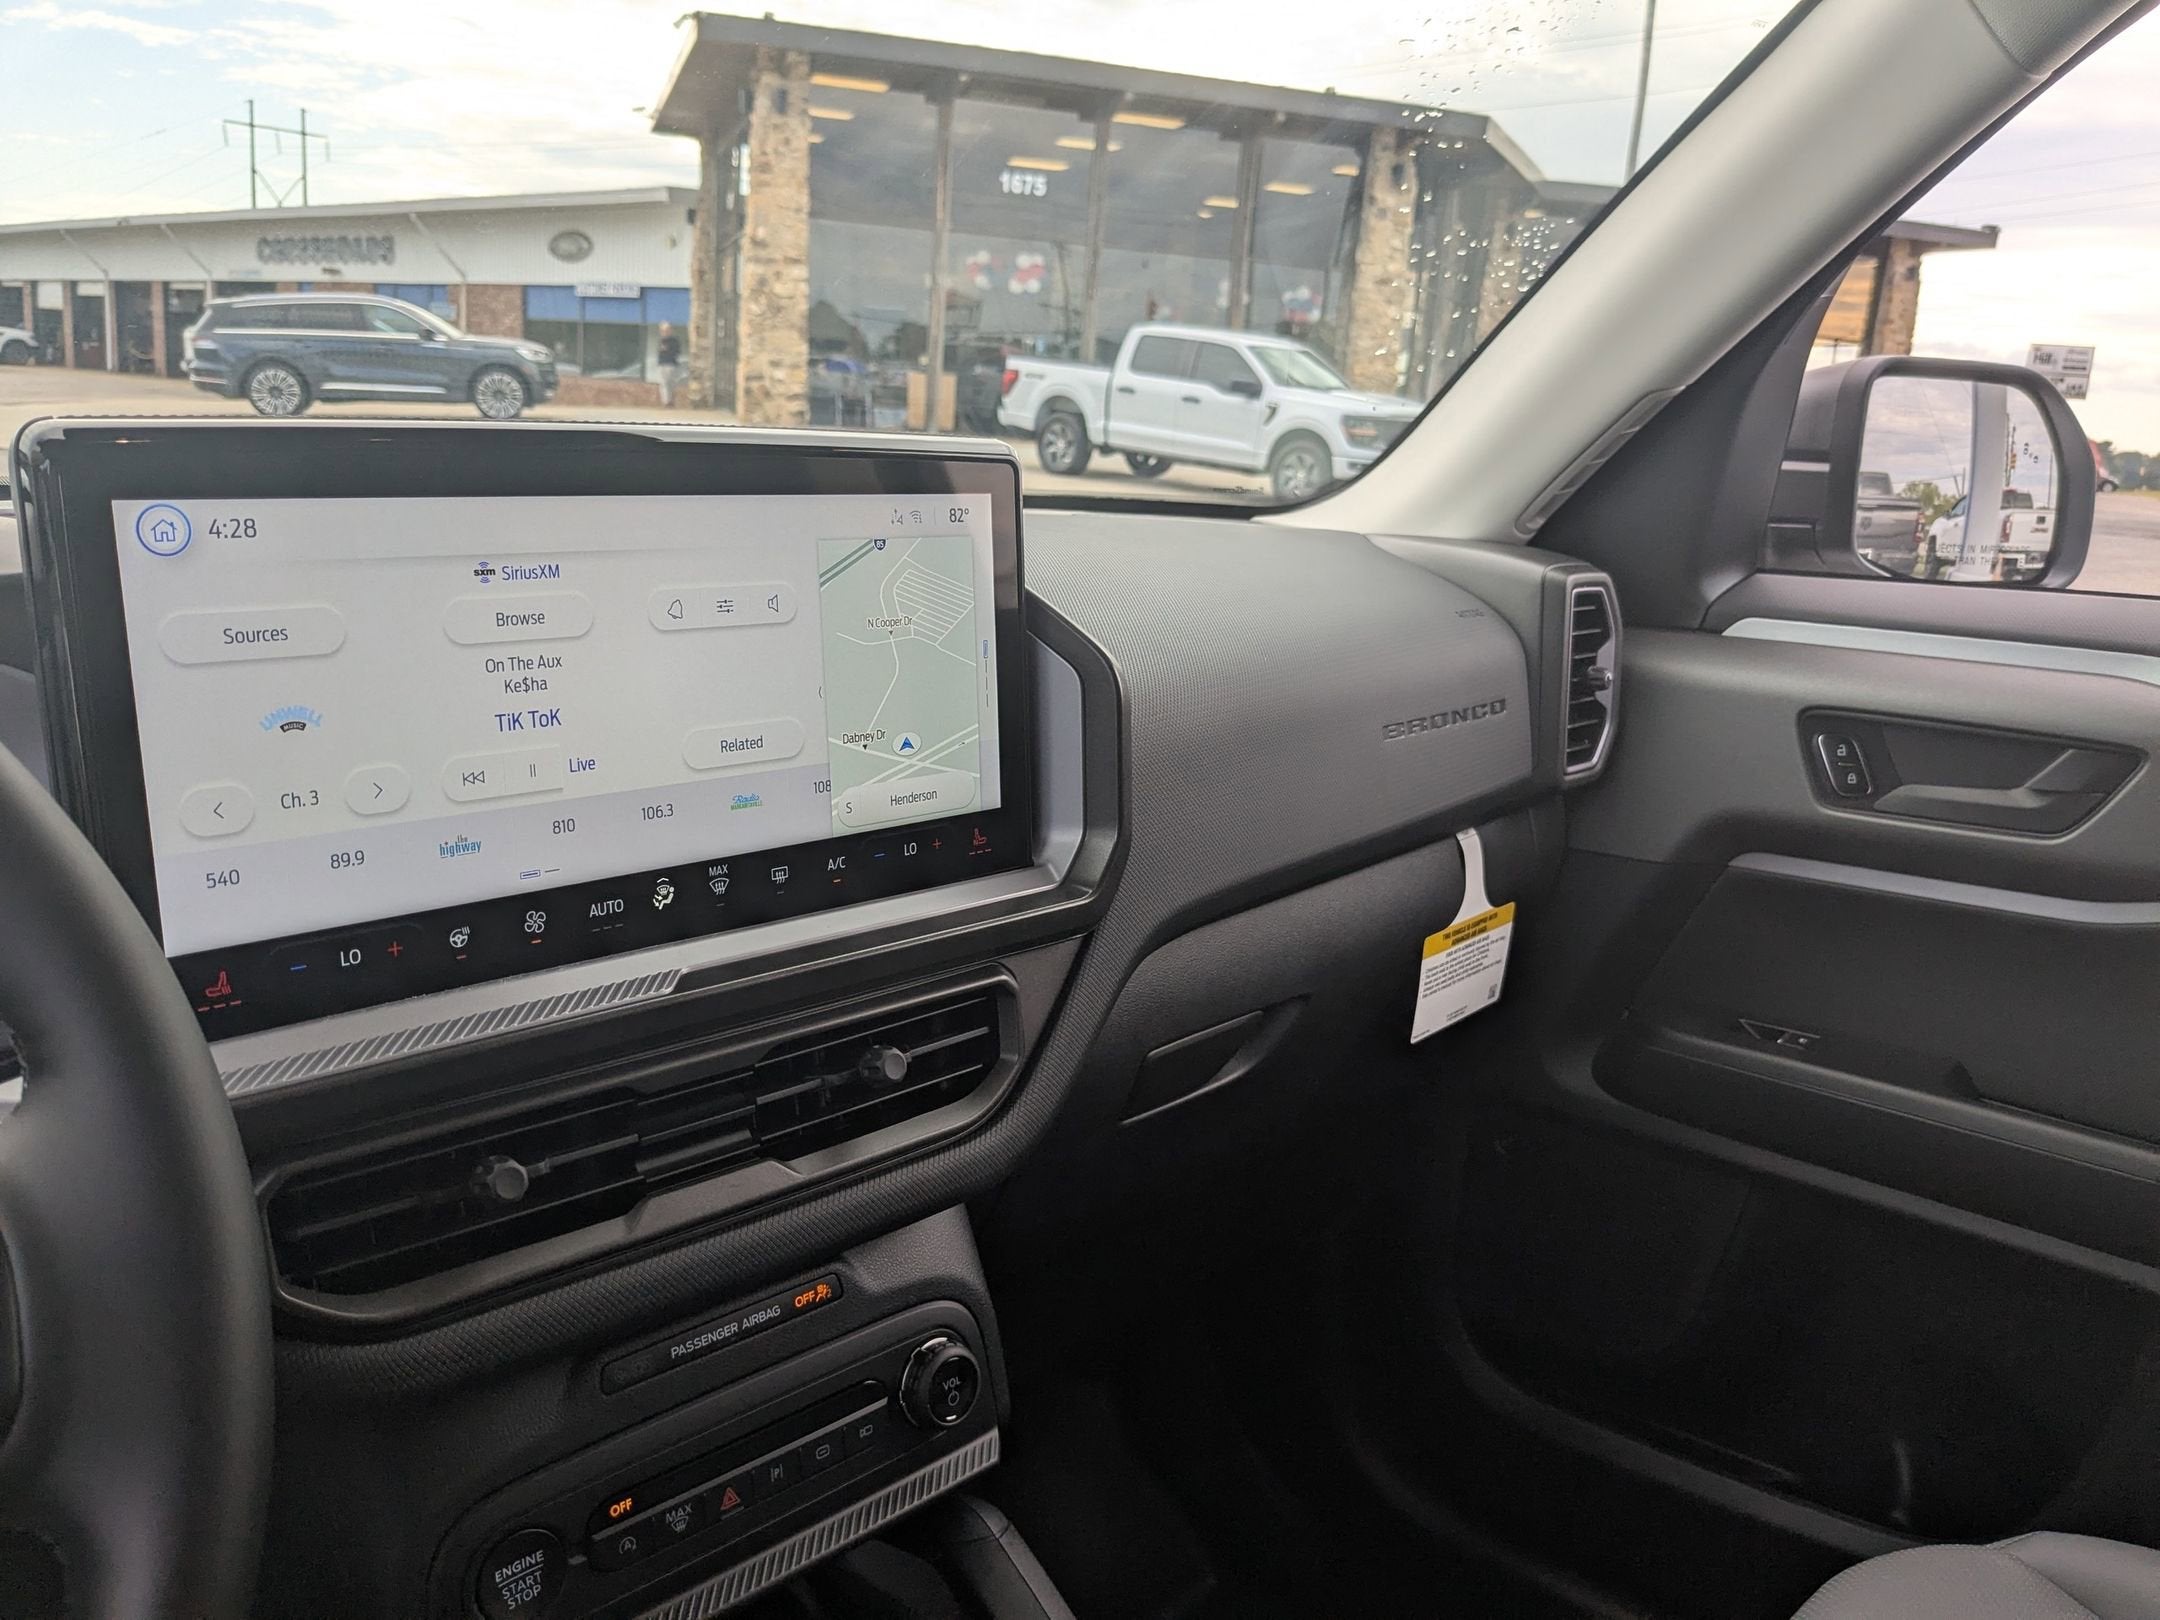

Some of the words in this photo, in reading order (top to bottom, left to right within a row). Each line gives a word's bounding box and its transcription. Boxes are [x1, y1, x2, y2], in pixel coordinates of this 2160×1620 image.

[1000, 172, 1047, 197] 1675
[208, 518, 257, 539] 4:28
[502, 564, 560, 580] SiriusXM
[496, 612, 545, 627] Browse
[867, 618, 874, 630] N
[876, 616, 902, 630] Cooper
[902, 615, 913, 627] Dr
[223, 627, 289, 645] Sources
[485, 659, 504, 673] On
[508, 656, 534, 672] The
[537, 655, 563, 670] Aux
[504, 677, 549, 694] Ke$ha
[495, 712, 524, 732] TiK
[528, 708, 562, 728] ToK
[1382, 698, 1506, 741] BRONCO
[720, 735, 764, 753] Related
[842, 732, 874, 744] Dabney
[875, 729, 886, 740] Dr
[569, 757, 596, 773] Live
[280, 792, 305, 809] Ch.
[309, 790, 320, 806] 3
[846, 802, 853, 814] S
[890, 791, 938, 807] Henderson
[641, 803, 674, 821] 106.3
[552, 818, 576, 835] 810
[440, 841, 481, 858] highway
[904, 842, 917, 856] LO
[330, 850, 365, 869] 89.9
[828, 856, 846, 871] A/C
[206, 869, 240, 889] 540
[709, 864, 728, 876] MAX
[589, 899, 624, 918] AUTO
[340, 948, 361, 967] LO
[795, 1290, 816, 1307] OFF
[670, 1322, 739, 1358] PASSENGER
[742, 1304, 781, 1330] AIRBAG
[942, 1377, 961, 1390] VOL
[609, 1498, 632, 1517] OFF
[665, 1503, 693, 1523] MAX
[495, 1550, 544, 1582] ENGINE
[502, 1571, 542, 1599] START
[508, 1585, 541, 1609] STOP
